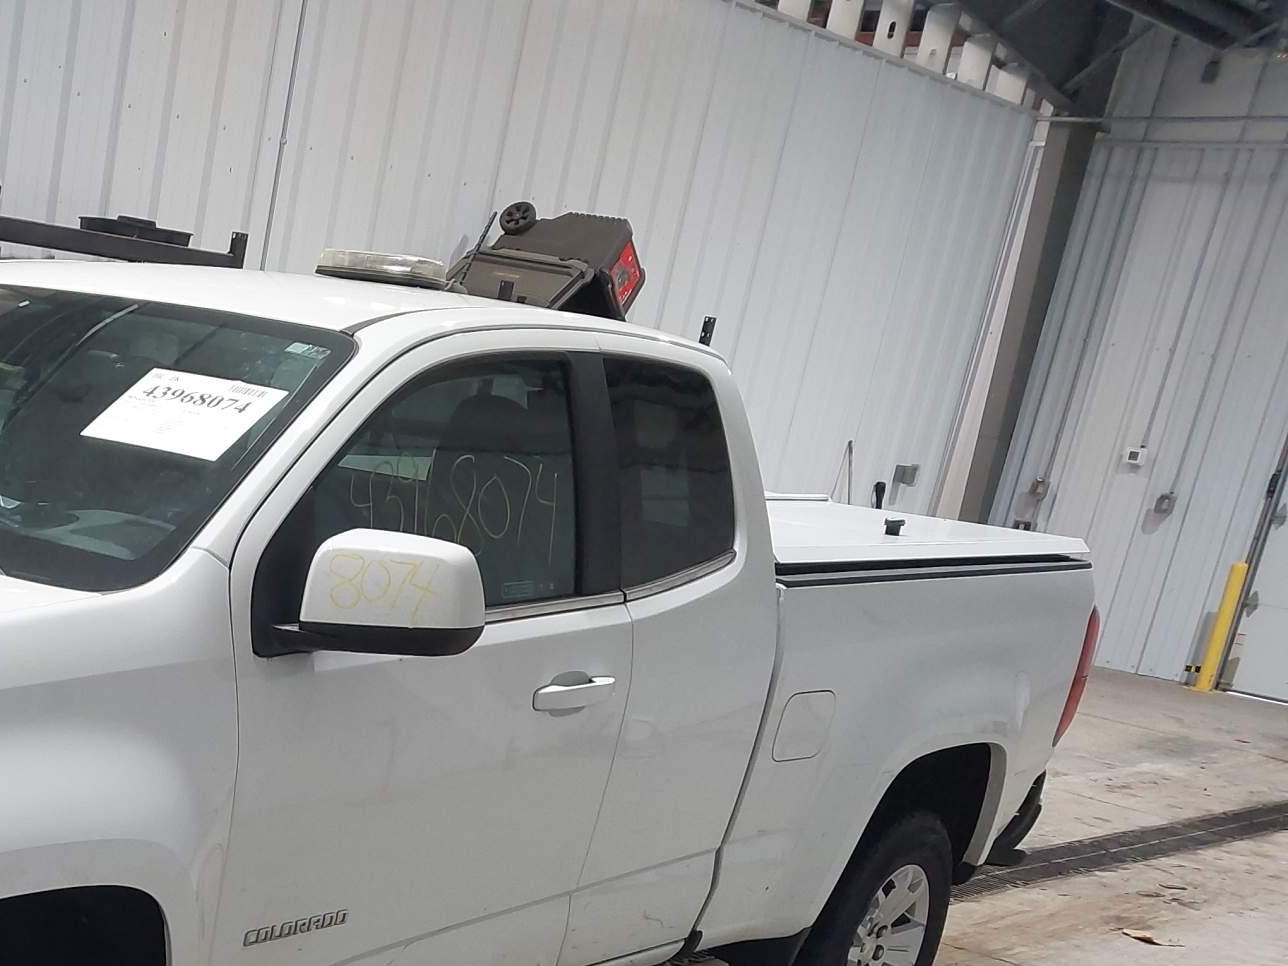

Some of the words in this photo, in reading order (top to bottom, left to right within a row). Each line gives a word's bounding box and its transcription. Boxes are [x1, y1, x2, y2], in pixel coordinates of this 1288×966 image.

[143, 384, 253, 415] 43968074
[328, 553, 441, 628] 8074
[243, 909, 350, 947] COLORADO
